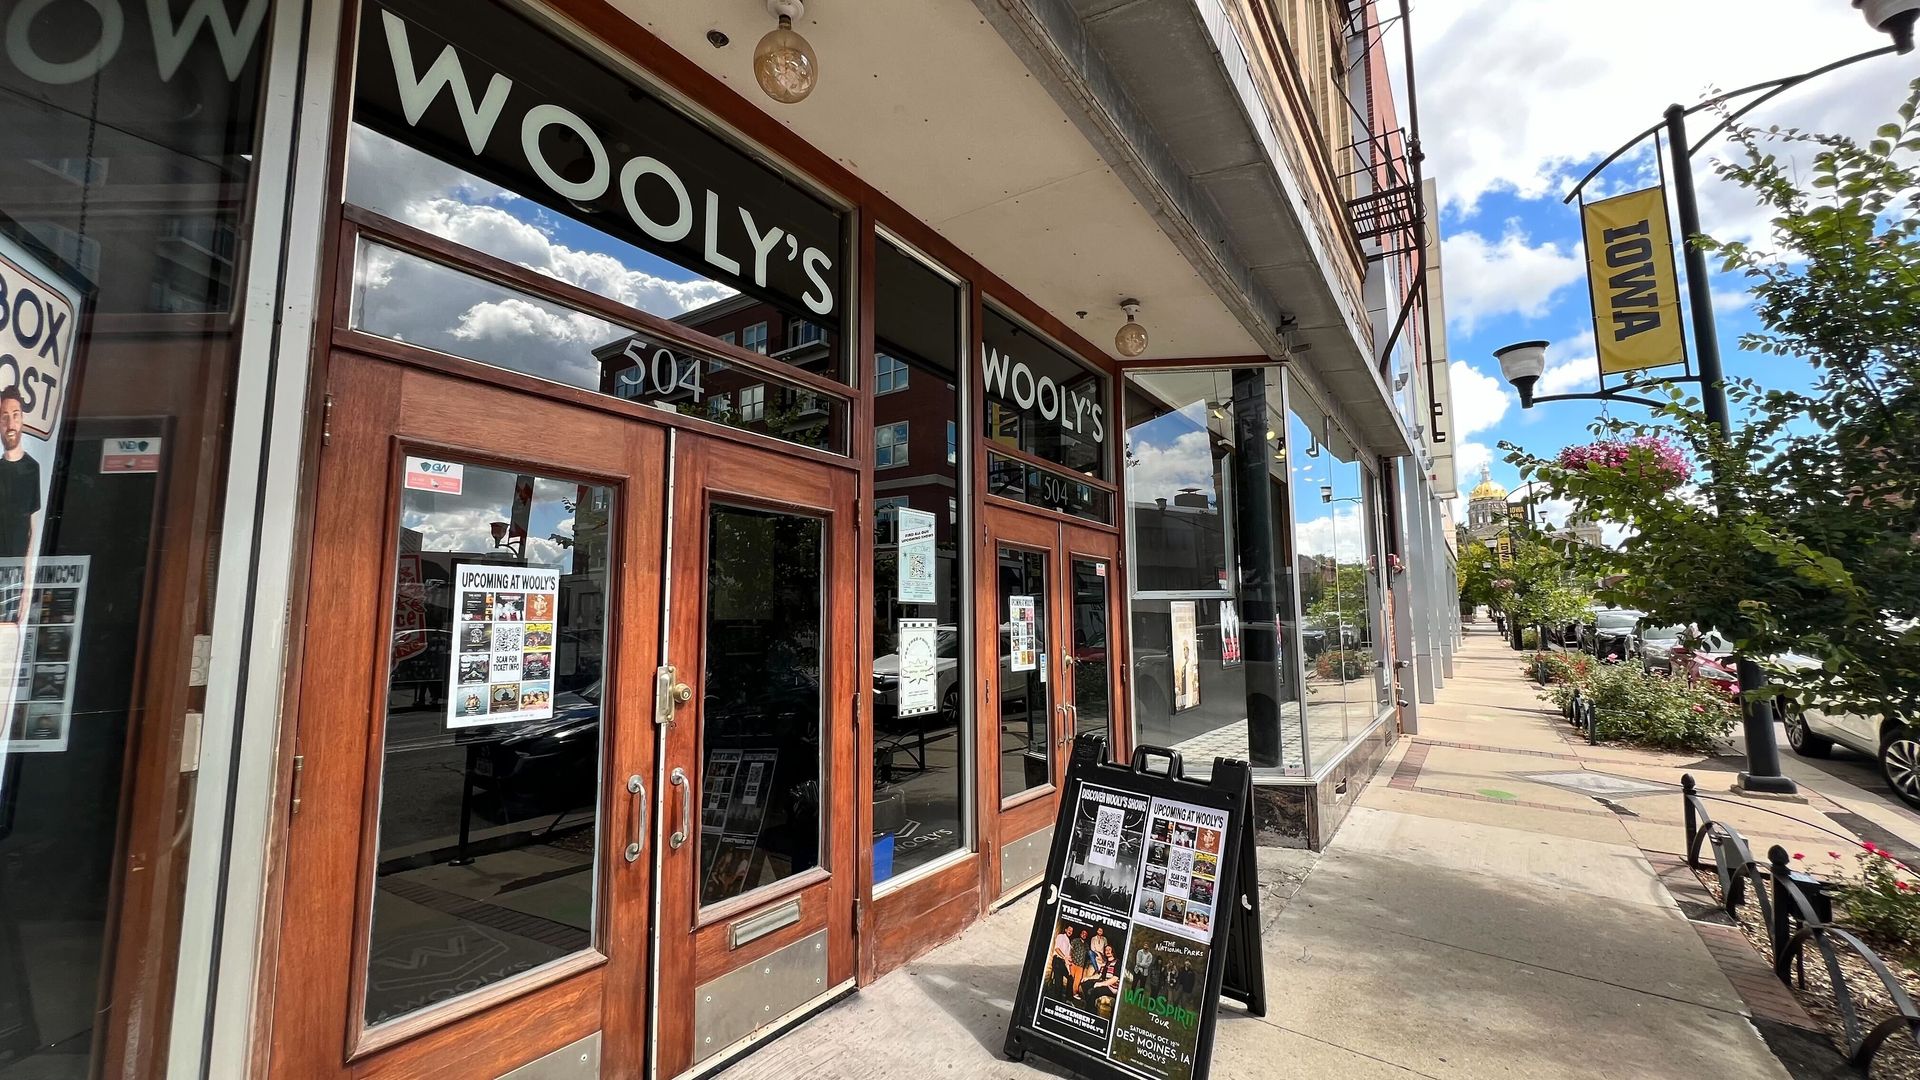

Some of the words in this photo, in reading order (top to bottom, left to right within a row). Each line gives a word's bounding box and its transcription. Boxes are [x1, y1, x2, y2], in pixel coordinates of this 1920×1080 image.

[382, 8, 833, 315] WOOLY'S
[1603, 219, 1664, 341] IOWA
[620, 338, 705, 403] 504
[981, 342, 1104, 443] WOOLY'S
[1044, 477, 1069, 505] 504
[1509, 506, 1525, 514] IOWA
[462, 572, 509, 588] UPCOMING
[510, 574, 520, 590] AT
[522, 575, 556, 591] WOOLY'S
[493, 663, 508, 671] TICKET
[509, 663, 520, 671] INFO
[496, 655, 508, 664] SCAN
[509, 656, 518, 664] FOR
[1082, 788, 1106, 804] DISCOVER
[1127, 798, 1147, 812] SHOWS
[1154, 803, 1186, 821] UPCOMING
[1186, 810, 1195, 822] AT
[1195, 811, 1224, 829] WOOLY'S
[1093, 844, 1106, 854] TICKET
[1096, 837, 1107, 847] SCAN
[1062, 904, 1079, 916] THE
[1079, 908, 1128, 930] DROPTINES
[1155, 943, 1184, 955] NATIONAL
[1183, 946, 1204, 957] PARKS
[1054, 1005, 1090, 1023] SEPTEMBER
[1148, 1012, 1171, 1030] TOUR
[1116, 1028, 1135, 1043] DES
[1137, 1036, 1178, 1060] MOINES,
[1180, 1052, 1191, 1065] IA
[1137, 1047, 1166, 1065] WOOLY'S
